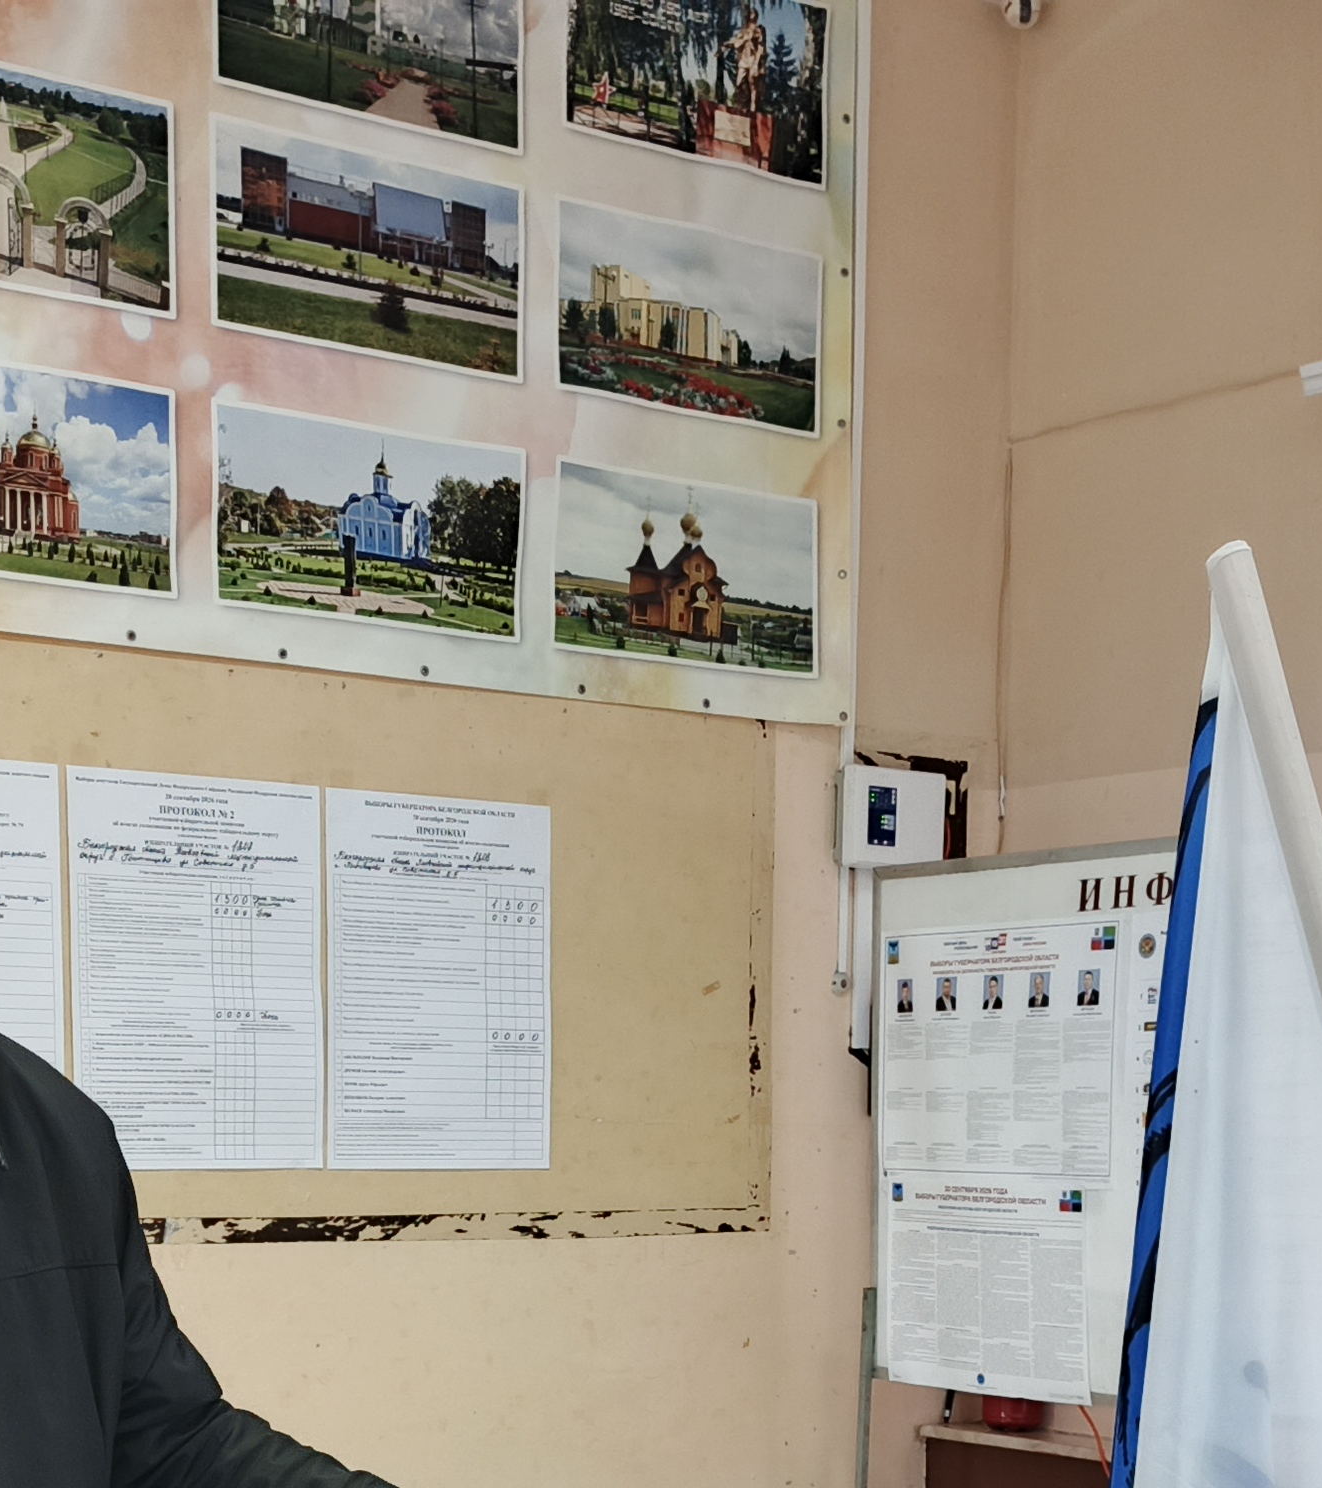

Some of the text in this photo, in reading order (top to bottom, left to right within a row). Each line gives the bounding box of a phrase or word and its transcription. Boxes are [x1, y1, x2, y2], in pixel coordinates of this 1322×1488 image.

[159, 805, 216, 818] ПРОТОКОЛ
[230, 811, 235, 819] 2
[416, 826, 466, 838] ПРОТОКОЛ
[530, 902, 538, 912] 0
[529, 916, 536, 925] 0
[491, 1031, 539, 1042] 0 0 0 0
